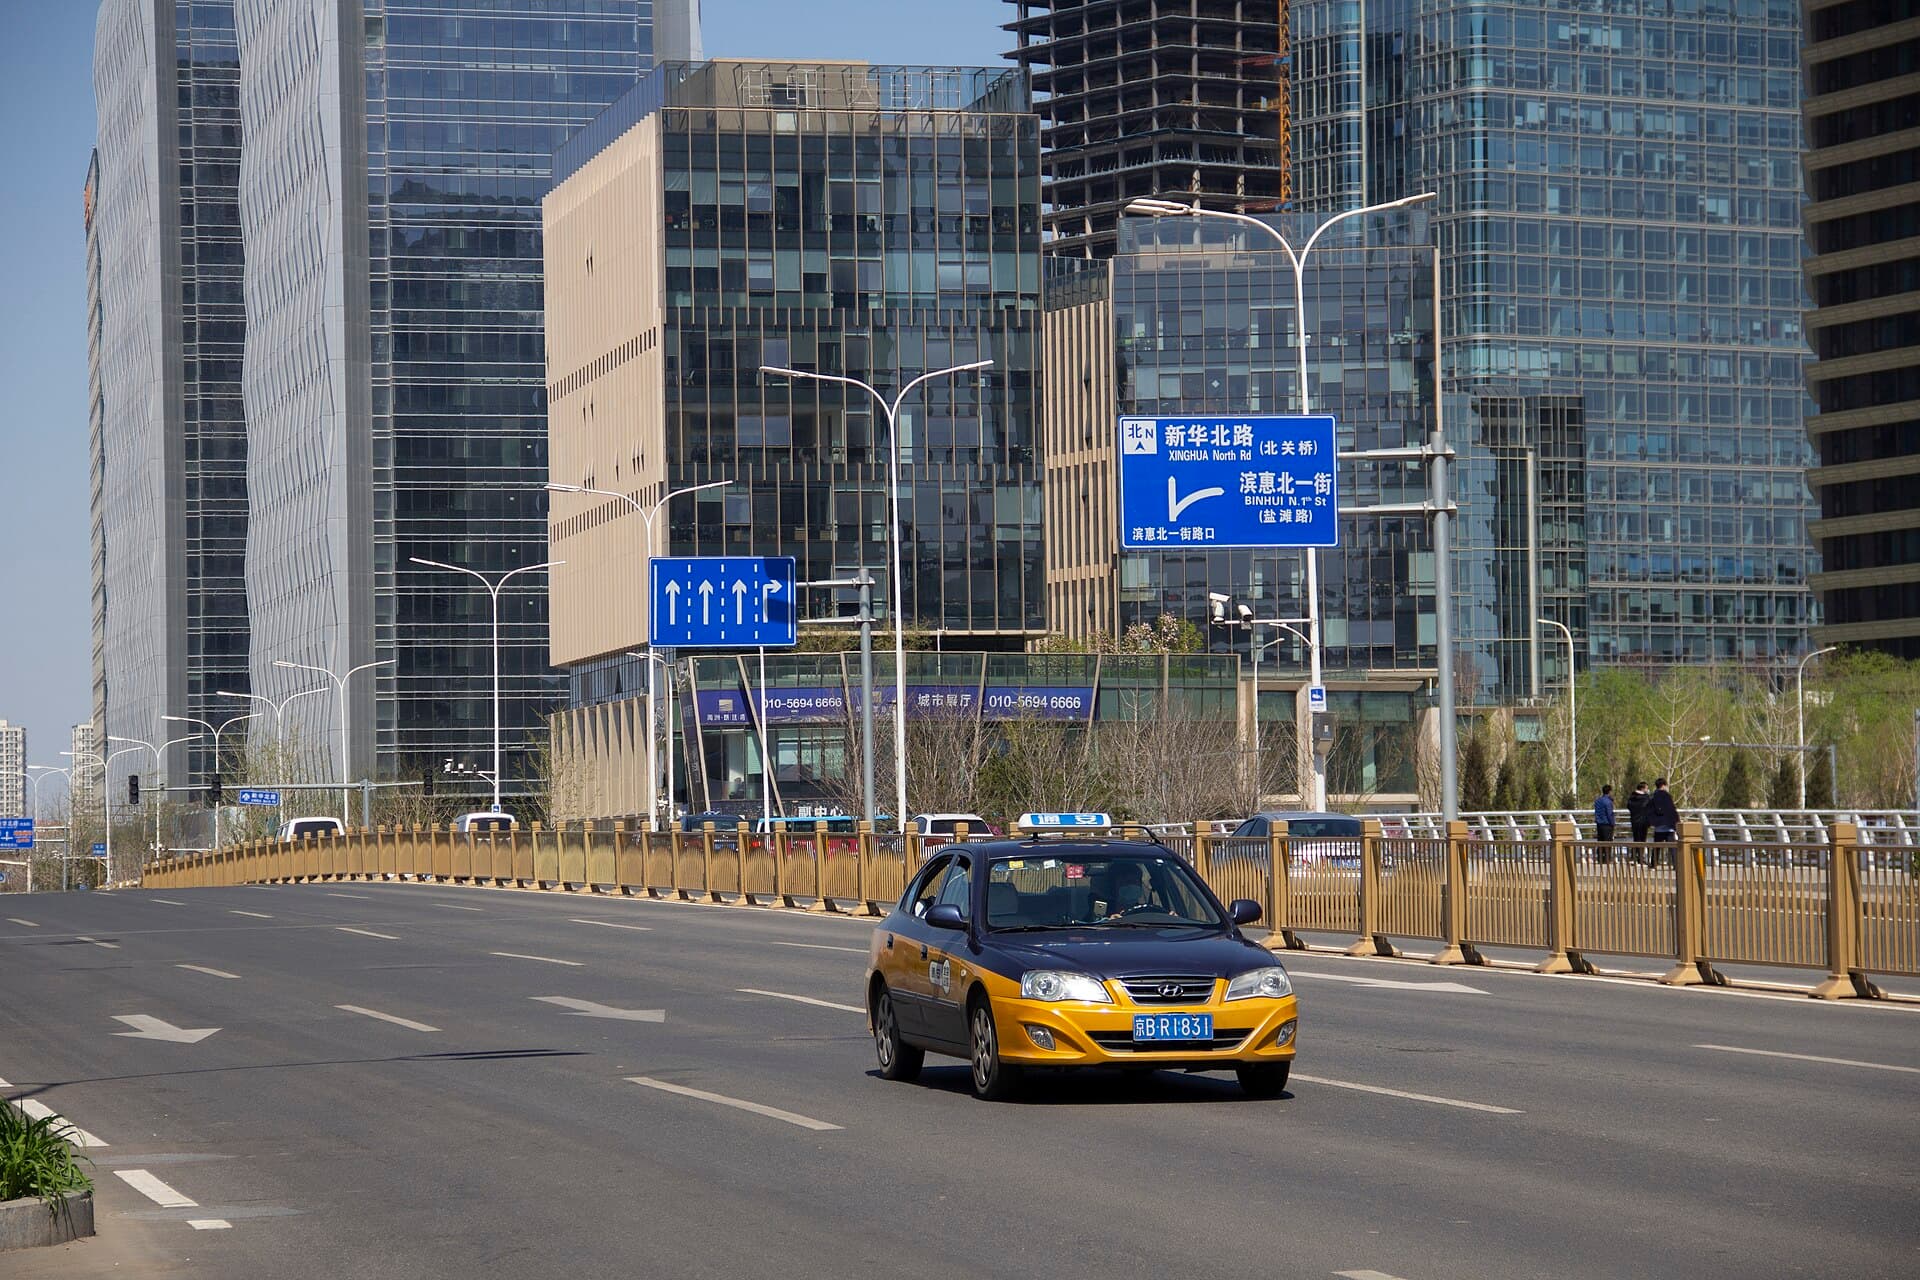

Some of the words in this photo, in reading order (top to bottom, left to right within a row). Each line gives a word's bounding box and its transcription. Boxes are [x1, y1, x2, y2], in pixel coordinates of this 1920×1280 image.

[1128, 424, 1143, 439] 北
[1145, 428, 1154, 439] N
[1164, 424, 1254, 447] 新华北路
[1168, 449, 1209, 461] XINGHUA
[1212, 450, 1236, 461] North
[1240, 450, 1252, 461] Rd
[1239, 471, 1332, 496] 滨惠北一街
[1244, 495, 1284, 506] BINHUI
[1314, 496, 1327, 507] St
[1132, 526, 1215, 541] 滨惠北一街路口
[815, 697, 842, 708] 6666
[917, 693, 971, 708] 城市展厅
[988, 695, 1048, 708] 010-5694
[1050, 696, 1081, 709] 6666
